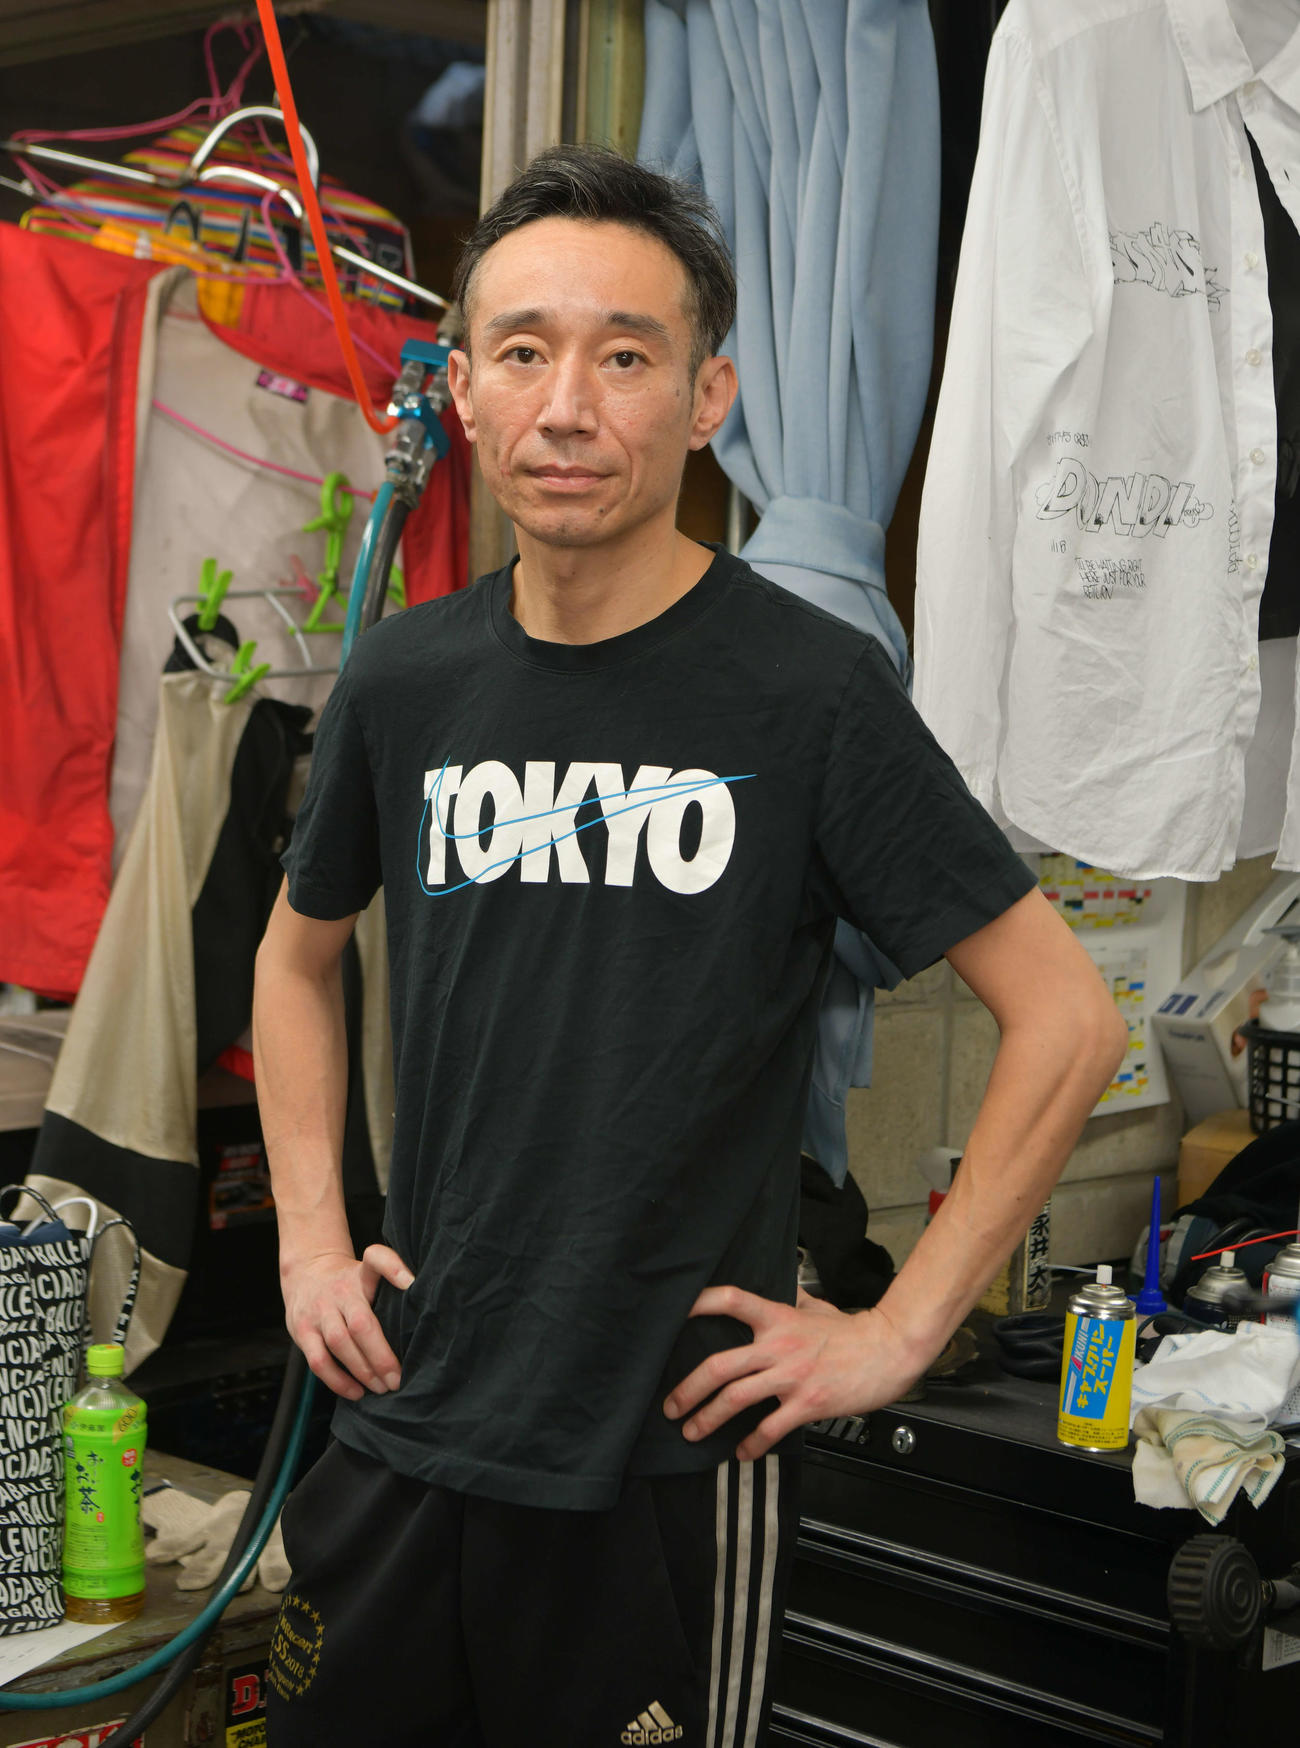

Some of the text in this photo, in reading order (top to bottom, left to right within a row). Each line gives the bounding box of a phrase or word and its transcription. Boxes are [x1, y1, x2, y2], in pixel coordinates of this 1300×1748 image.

[424, 760, 736, 895] TOKYO
[1093, 1335, 1115, 1395] スーパー
[274, 1633, 289, 1661] SS
[284, 1654, 306, 1679] 2018
[620, 1725, 683, 1746] adidas
